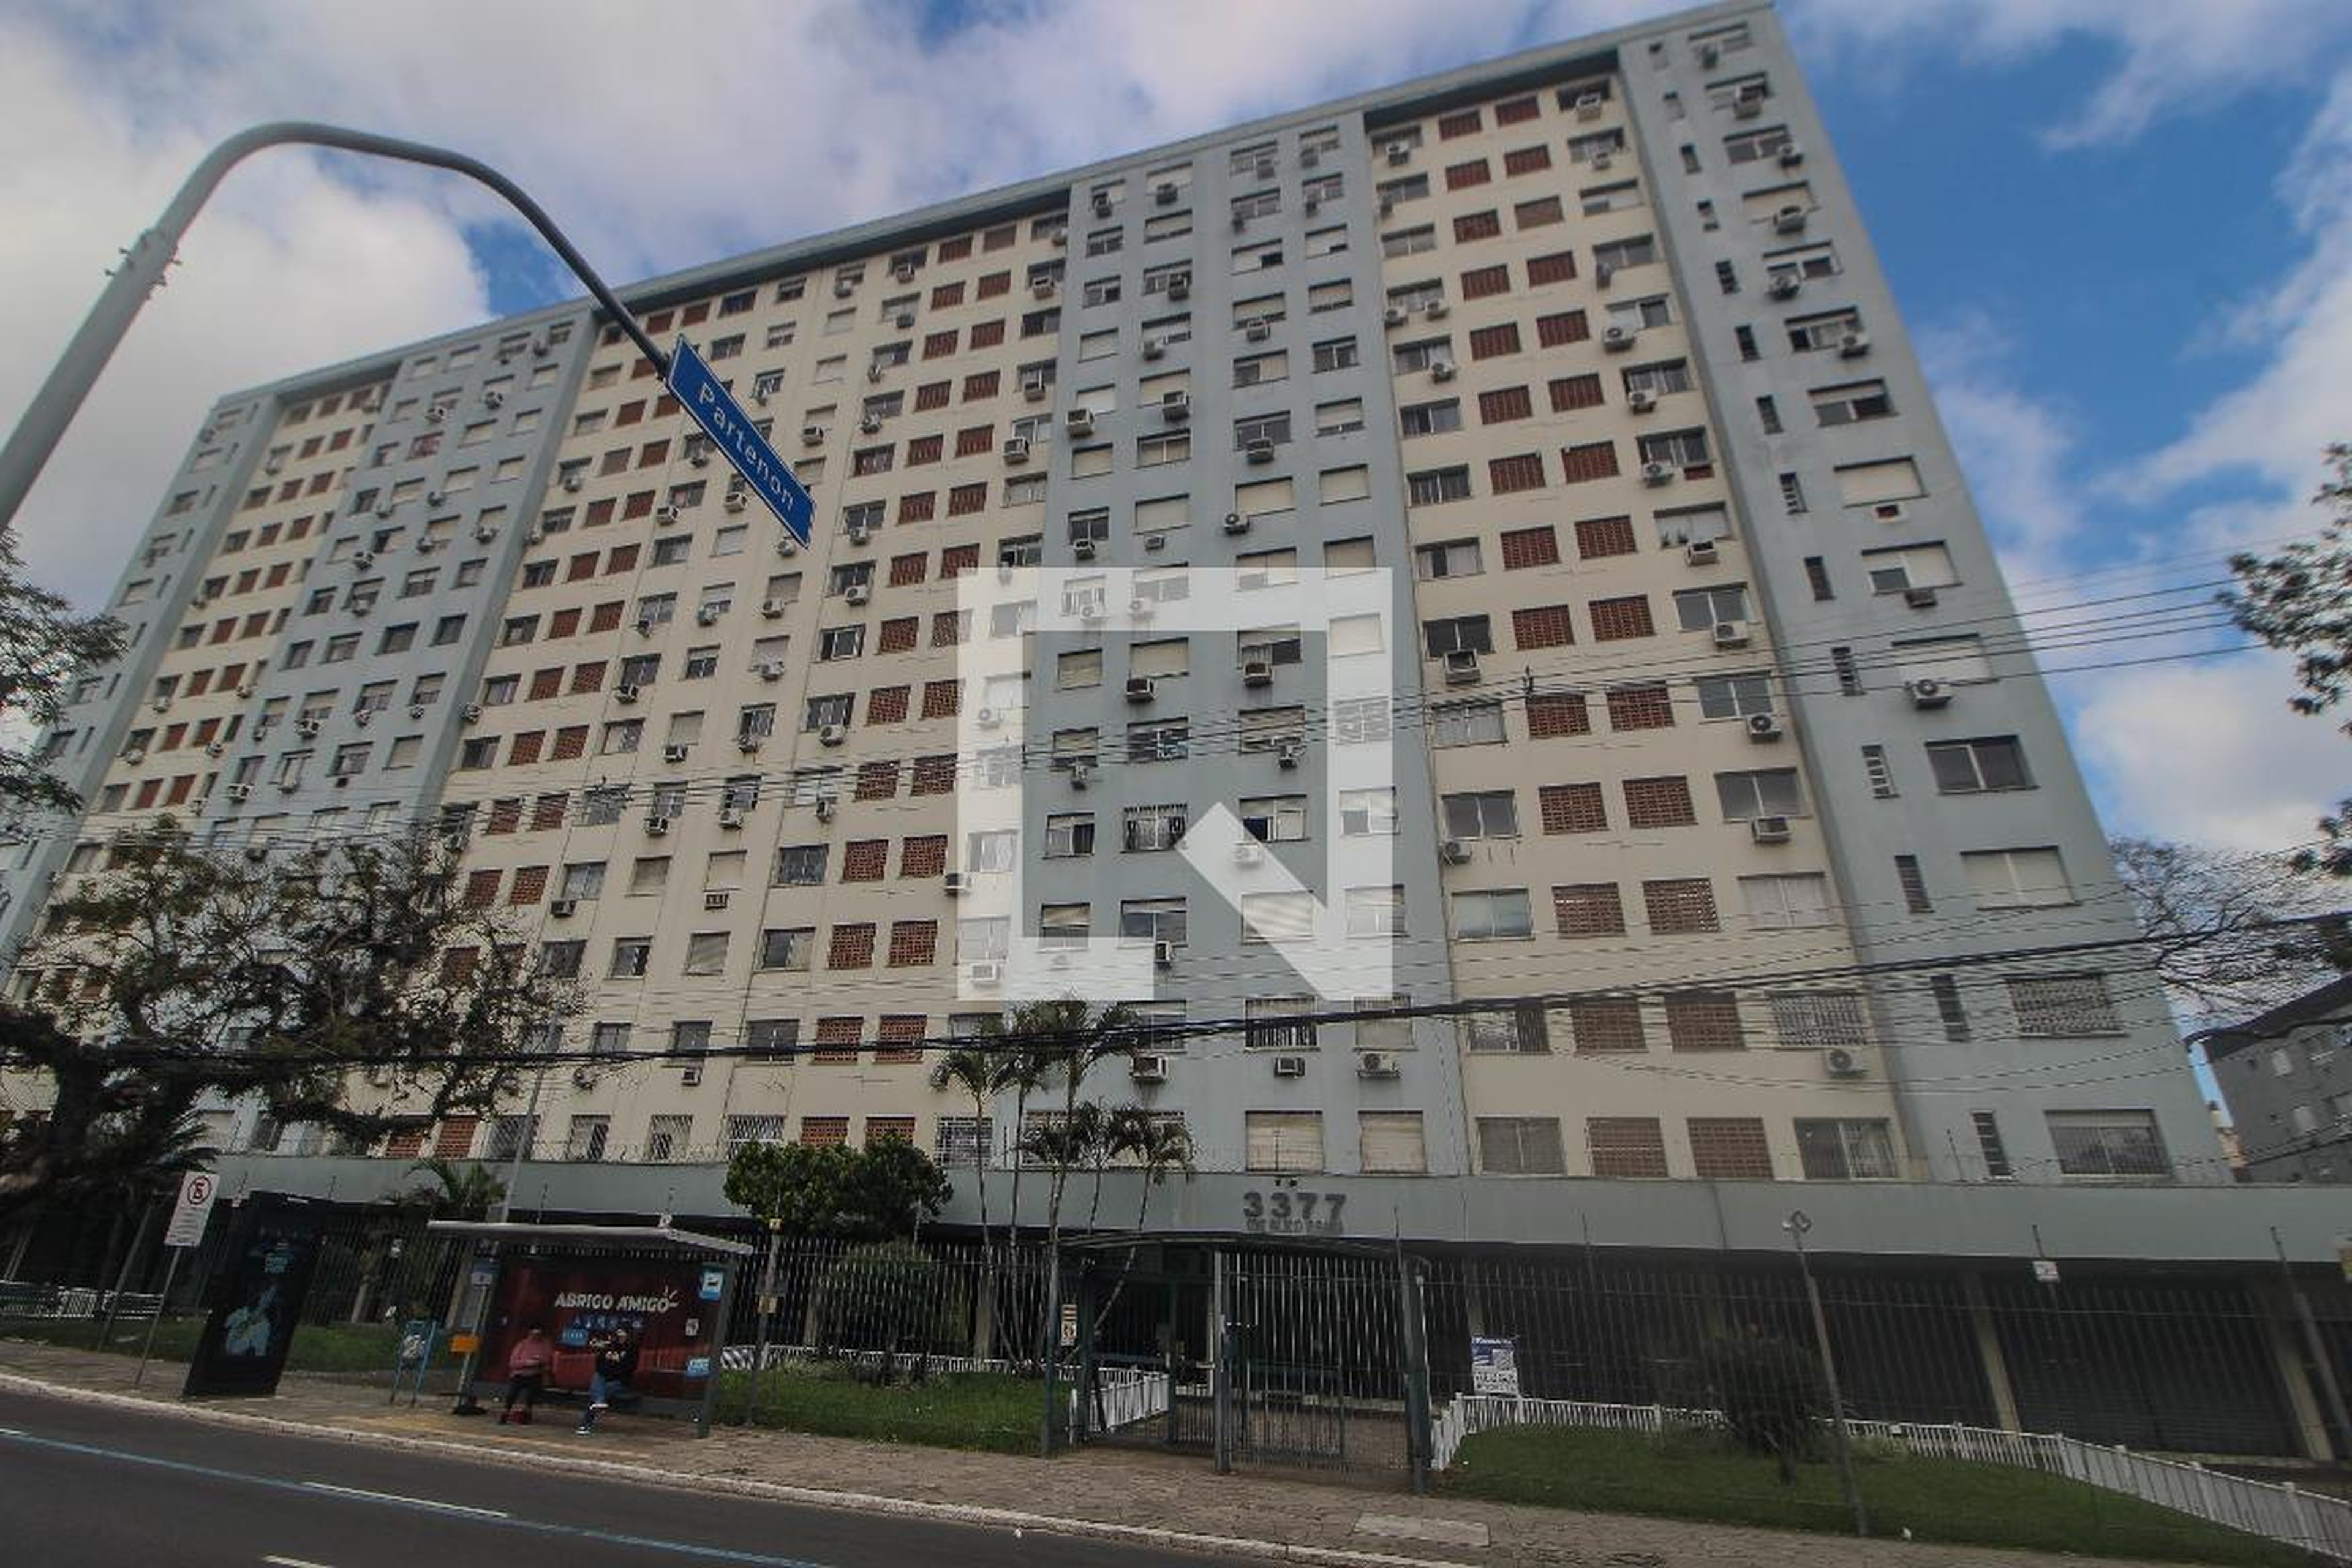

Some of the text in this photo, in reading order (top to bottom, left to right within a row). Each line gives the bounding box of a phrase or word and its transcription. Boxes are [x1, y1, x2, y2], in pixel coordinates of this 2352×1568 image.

[699, 383, 793, 510] Partenon
[1243, 1191, 1347, 1221] 3377
[554, 1292, 670, 1313] ABRIGO AMIGO
